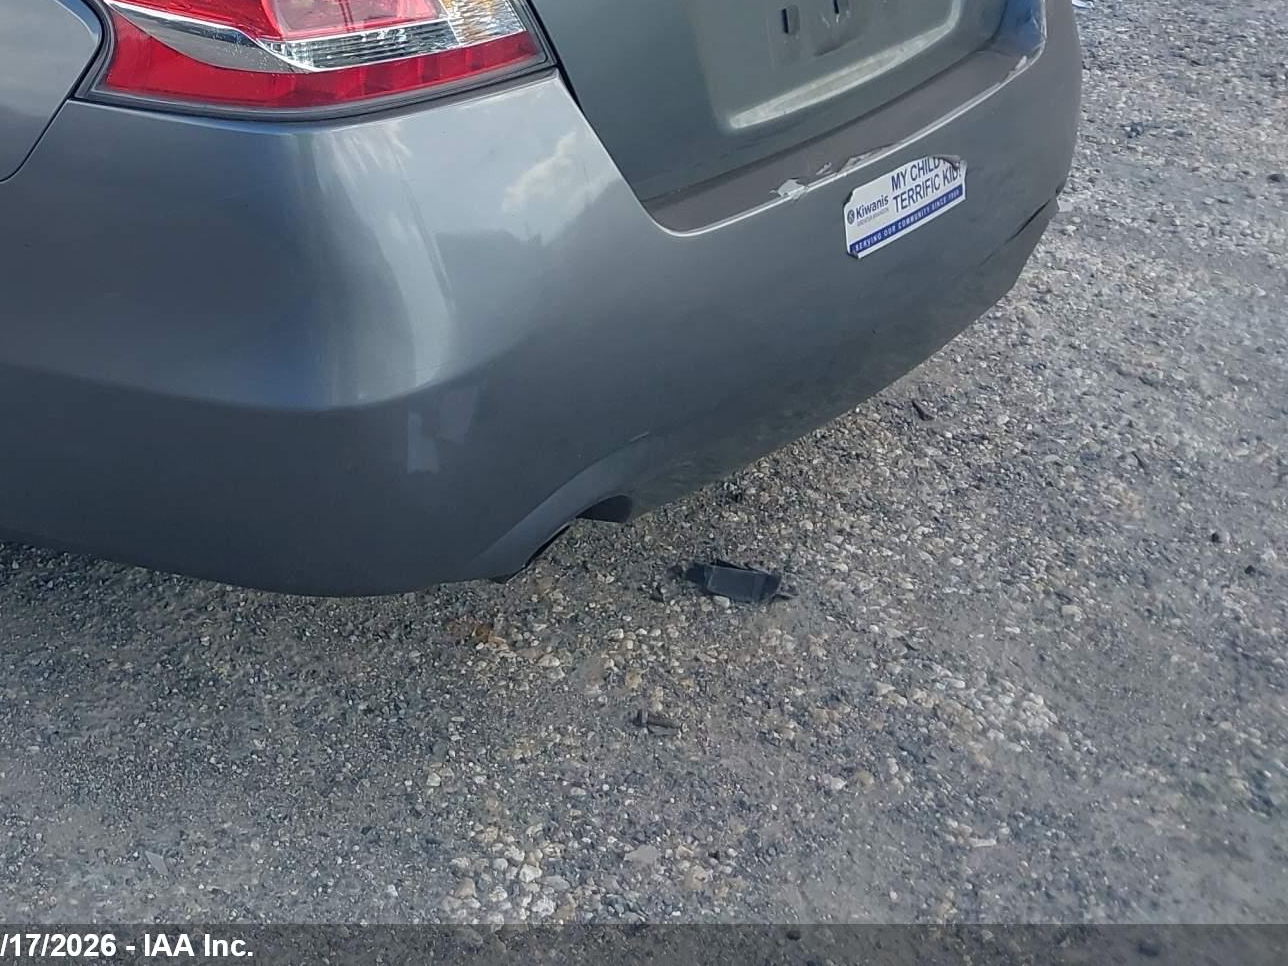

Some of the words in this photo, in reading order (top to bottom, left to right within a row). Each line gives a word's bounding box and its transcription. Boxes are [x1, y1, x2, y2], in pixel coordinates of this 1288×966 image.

[891, 172, 908, 193] MY
[892, 174, 941, 214] TERRIFIC
[855, 194, 889, 220] Kiwanis
